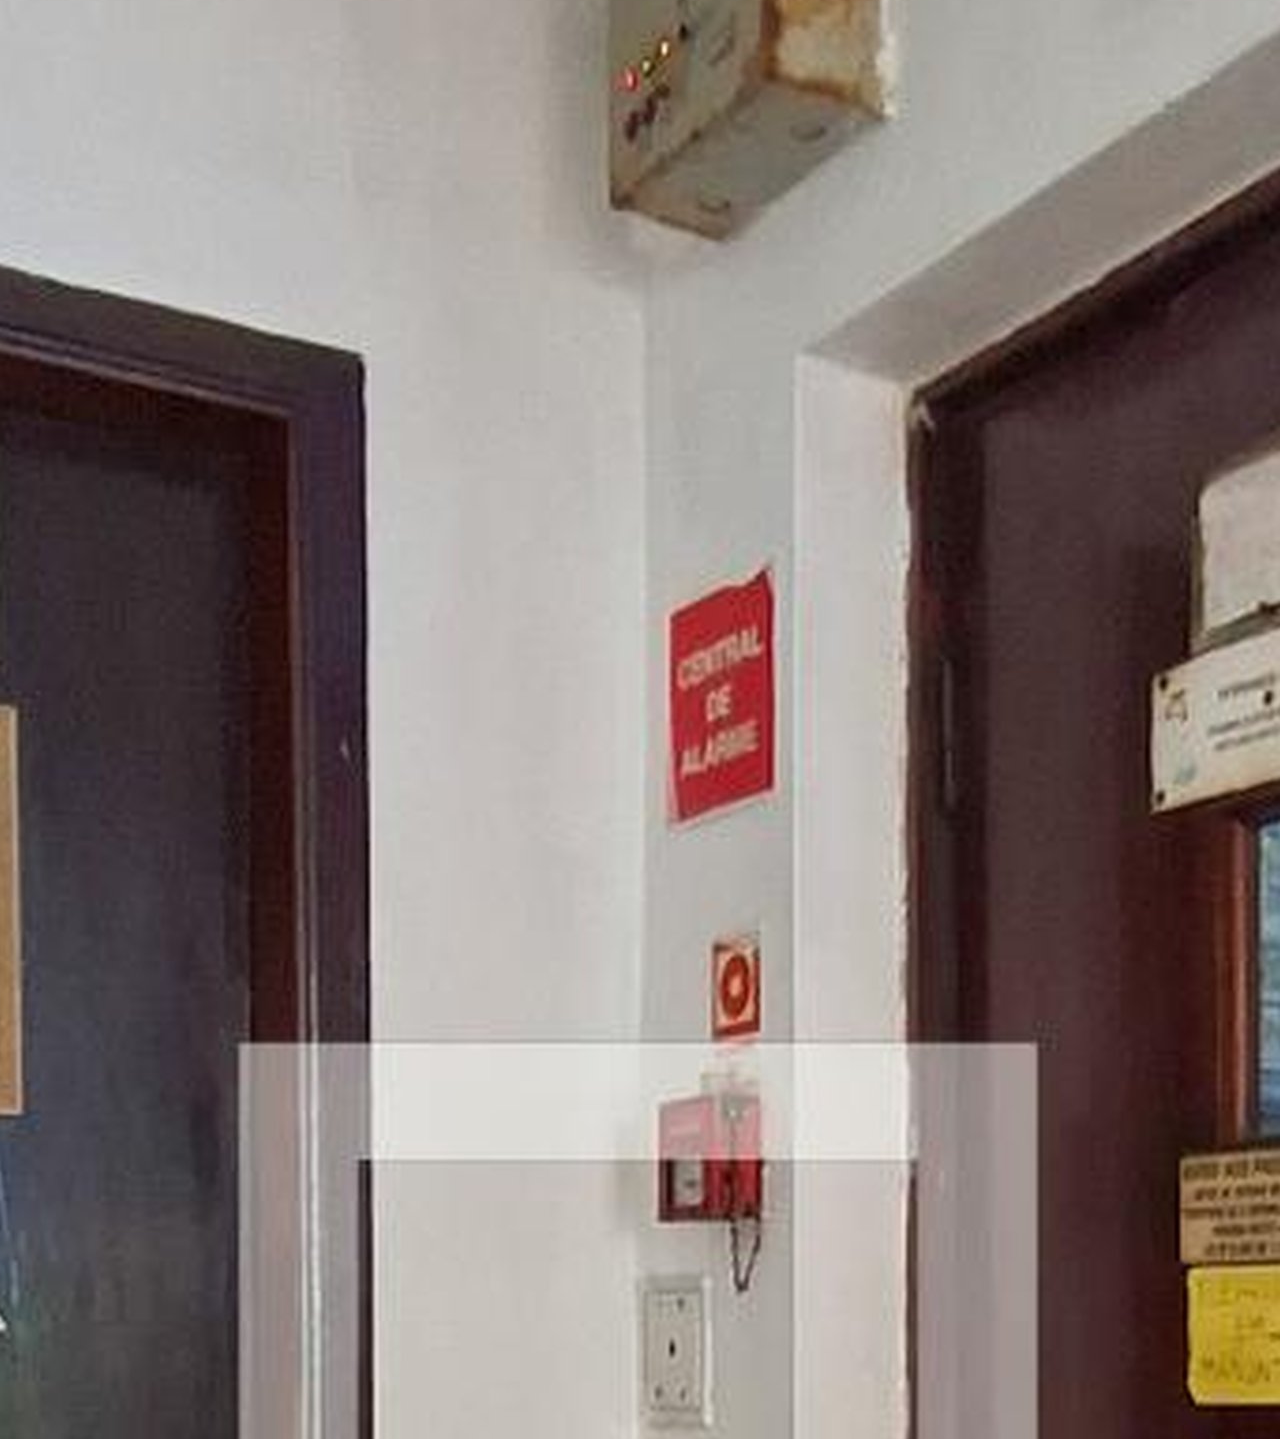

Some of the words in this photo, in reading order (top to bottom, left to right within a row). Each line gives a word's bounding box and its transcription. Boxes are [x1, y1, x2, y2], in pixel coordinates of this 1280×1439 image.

[676, 623, 764, 692] CENTRAL
[705, 682, 731, 723] DE
[680, 717, 759, 782] ALARME
